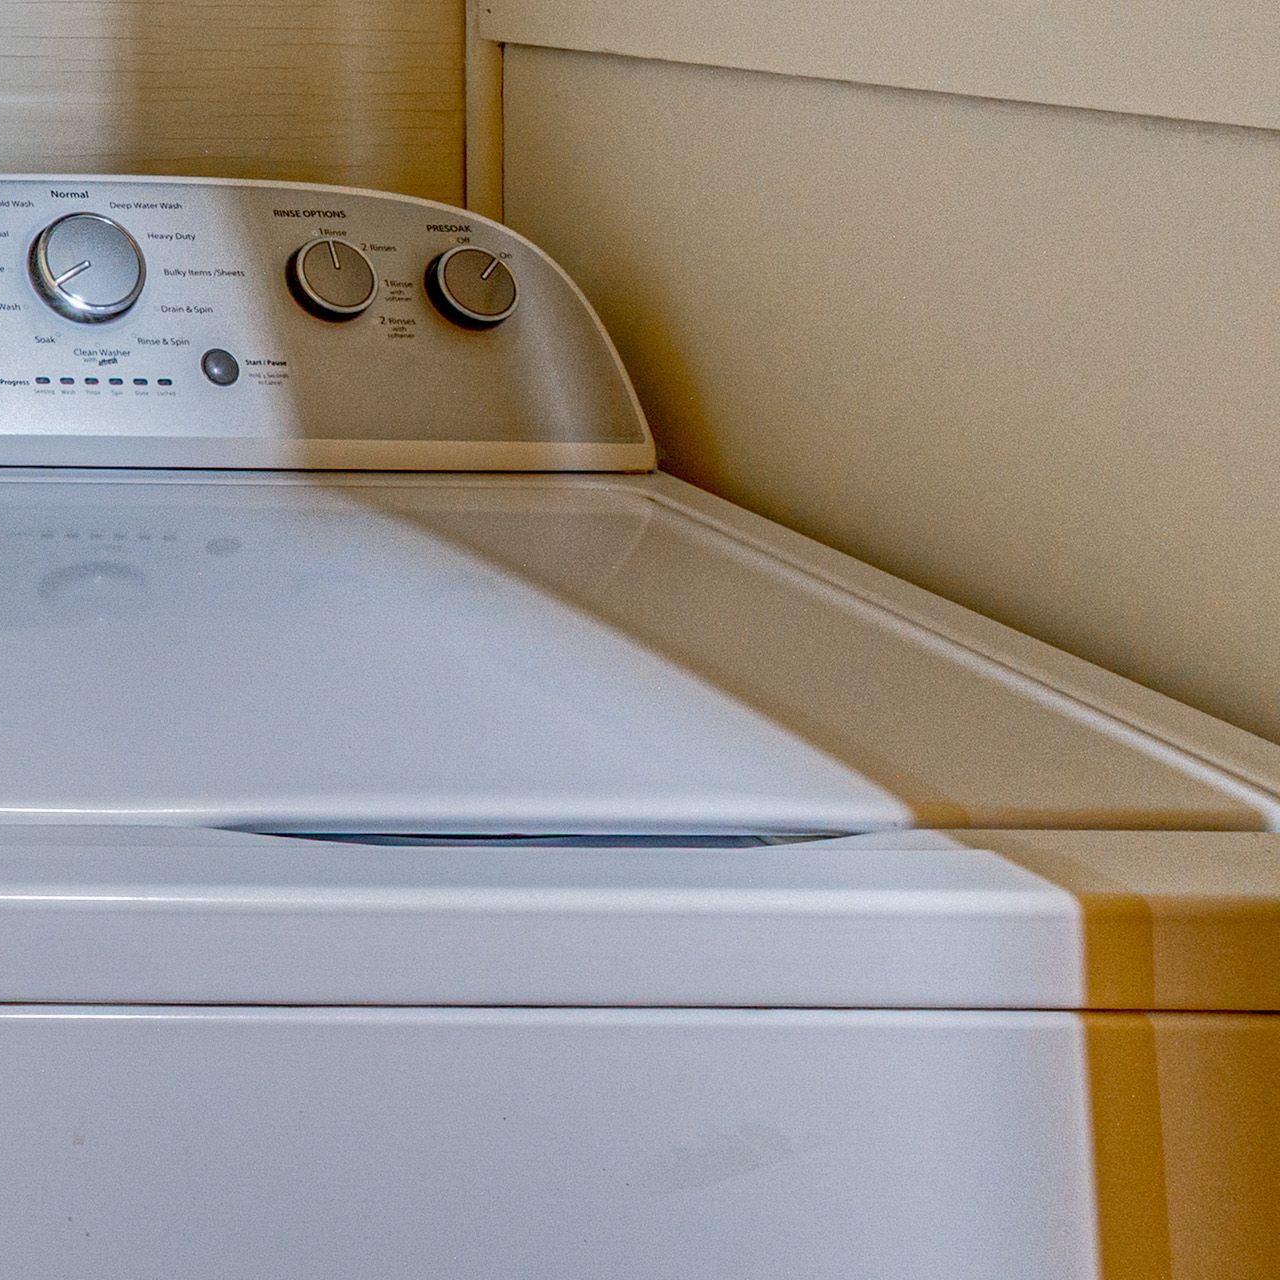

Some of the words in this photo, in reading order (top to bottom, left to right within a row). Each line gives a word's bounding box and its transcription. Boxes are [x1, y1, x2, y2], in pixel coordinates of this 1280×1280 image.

[50, 189, 90, 199] Normal
[11, 199, 34, 208] Wash
[109, 201, 134, 211] Deep
[136, 201, 158, 210] Water
[159, 201, 183, 210] Wash
[273, 209, 301, 218] RINSE
[303, 209, 347, 219] OPTIONS
[325, 228, 347, 237] Rinse
[426, 224, 472, 233] PRESOAK
[147, 232, 173, 242] Heavy
[175, 232, 196, 242] Duty
[370, 244, 397, 252] Rinses
[164, 268, 187, 278] Bulky
[189, 268, 212, 277] Items
[390, 280, 413, 288] Rinse
[161, 305, 184, 314] Drain
[193, 305, 213, 316] Spin
[388, 317, 416, 325] Rinses
[34, 335, 55, 344] Soak
[137, 337, 160, 346] Rinse
[171, 337, 190, 348] Spin
[73, 347, 96, 357] Clean
[98, 348, 131, 357] Washer
[267, 359, 287, 368] Pause
[0, 378, 30, 387] Progress
